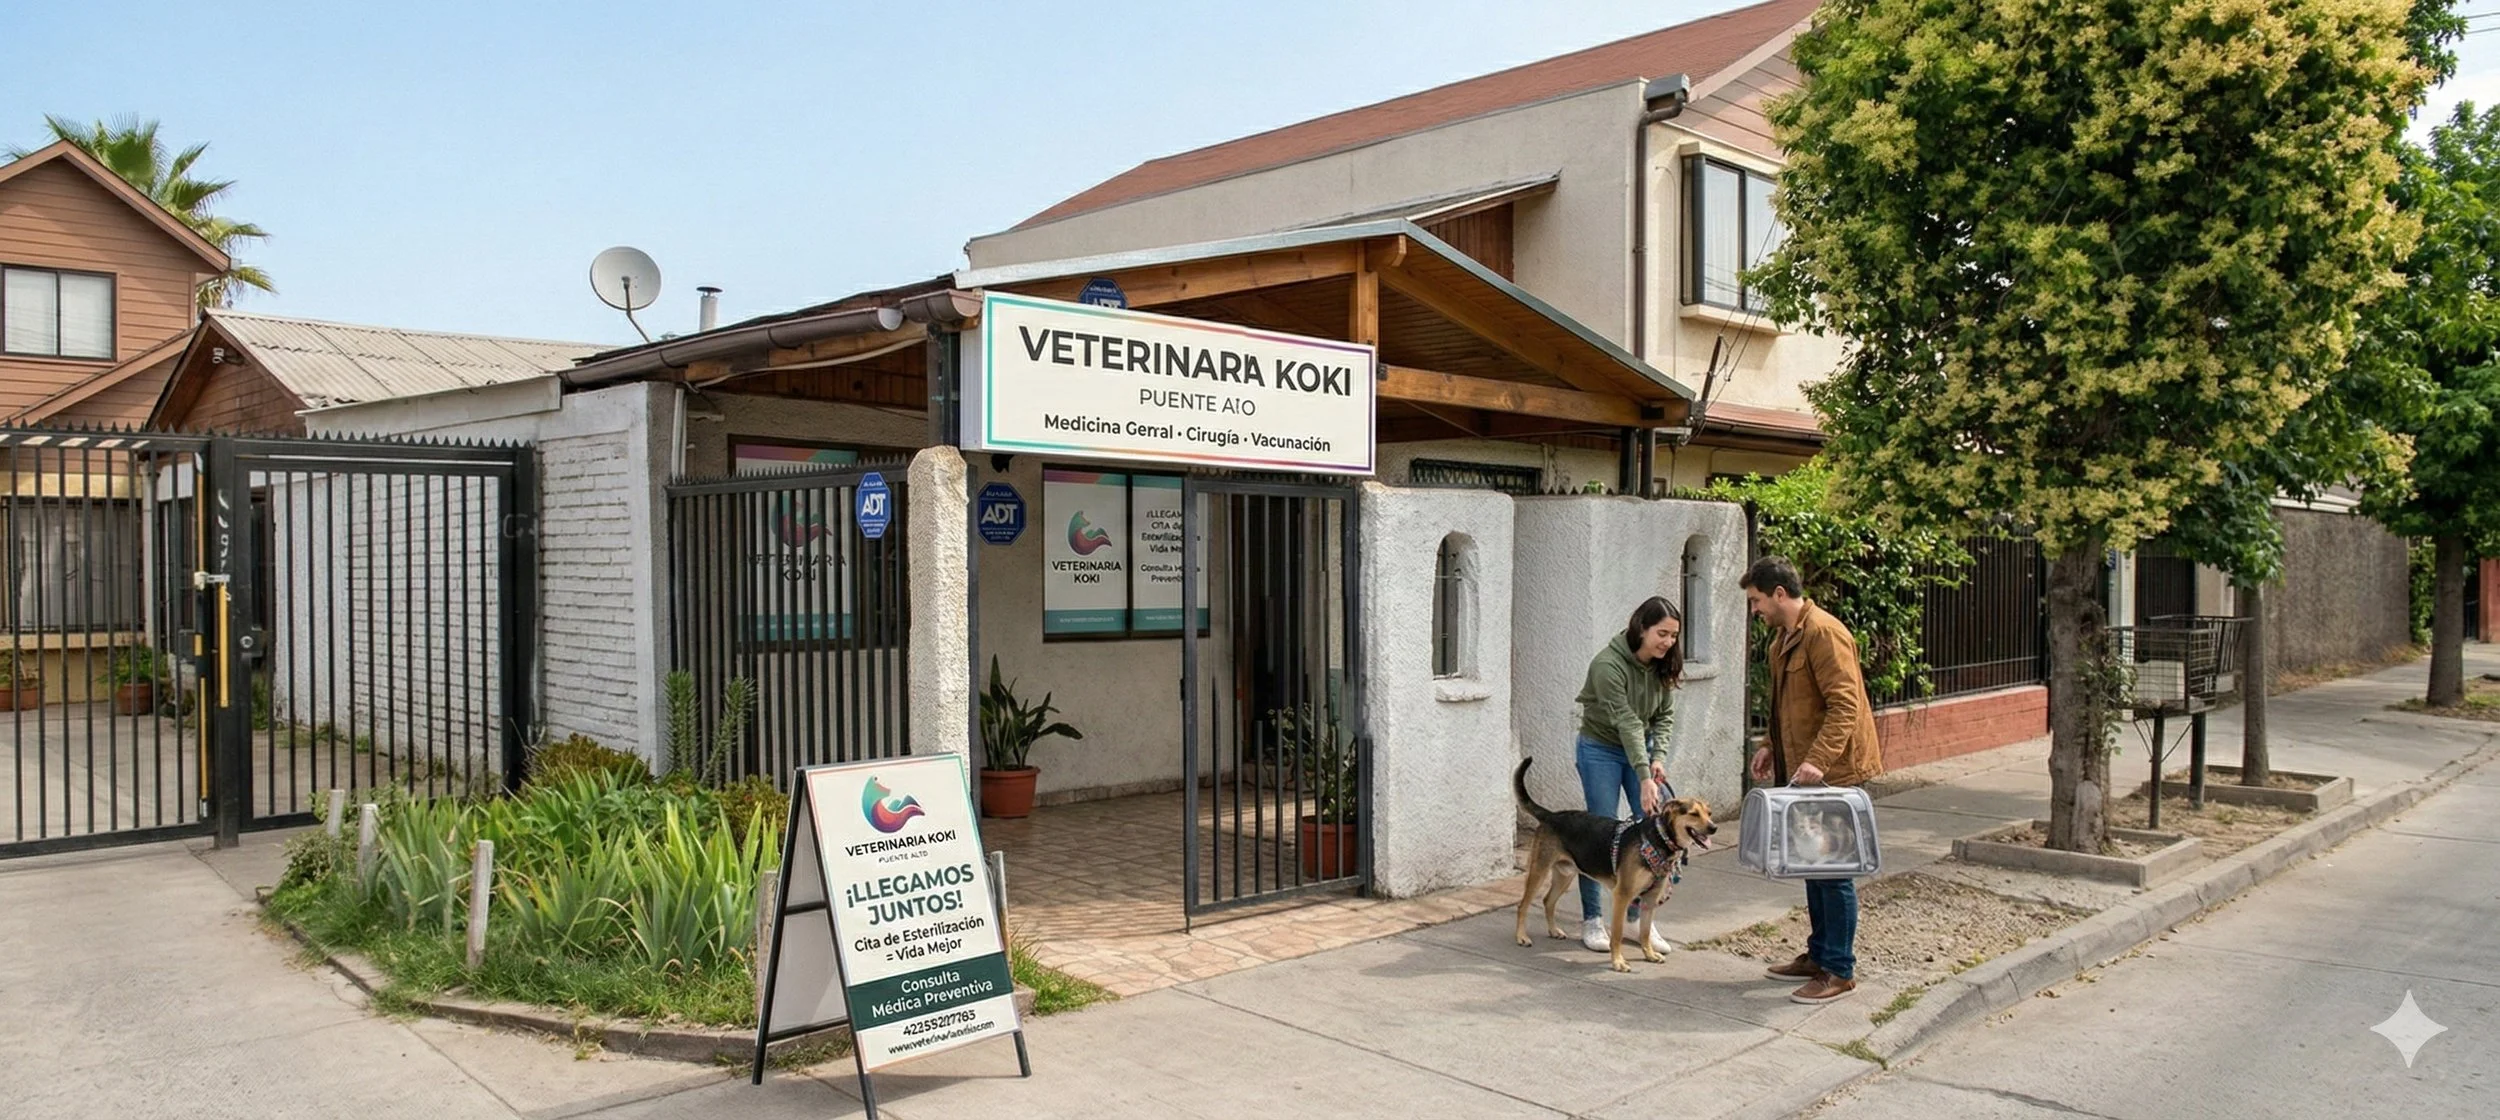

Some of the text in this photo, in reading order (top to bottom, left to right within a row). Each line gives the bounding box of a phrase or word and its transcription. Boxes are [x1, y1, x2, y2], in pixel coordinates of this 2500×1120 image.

[1275, 358, 1352, 397] KOKI
[1139, 388, 1217, 412] PUENTE
[1044, 413, 1121, 435] Medicina
[1186, 426, 1240, 447] Cirugía
[1251, 432, 1331, 452] Vacunación
[861, 493, 886, 517] ADT
[980, 503, 1018, 524] ADT
[1052, 561, 1122, 571] VETERINARIA
[1074, 573, 1100, 584] KOKI
[845, 829, 956, 857] VETERINARIA KOKI
[878, 853, 909, 864] PUENTE
[846, 863, 975, 909] ¡LLEGAMOS
[868, 889, 964, 926] JUNTOS!
[854, 916, 985, 952] Cita de Esterilización
[895, 945, 925, 961] Vida
[927, 937, 962, 955] Mejor
[901, 970, 960, 994] Consulta
[872, 979, 994, 1018] Médica Preventiva
